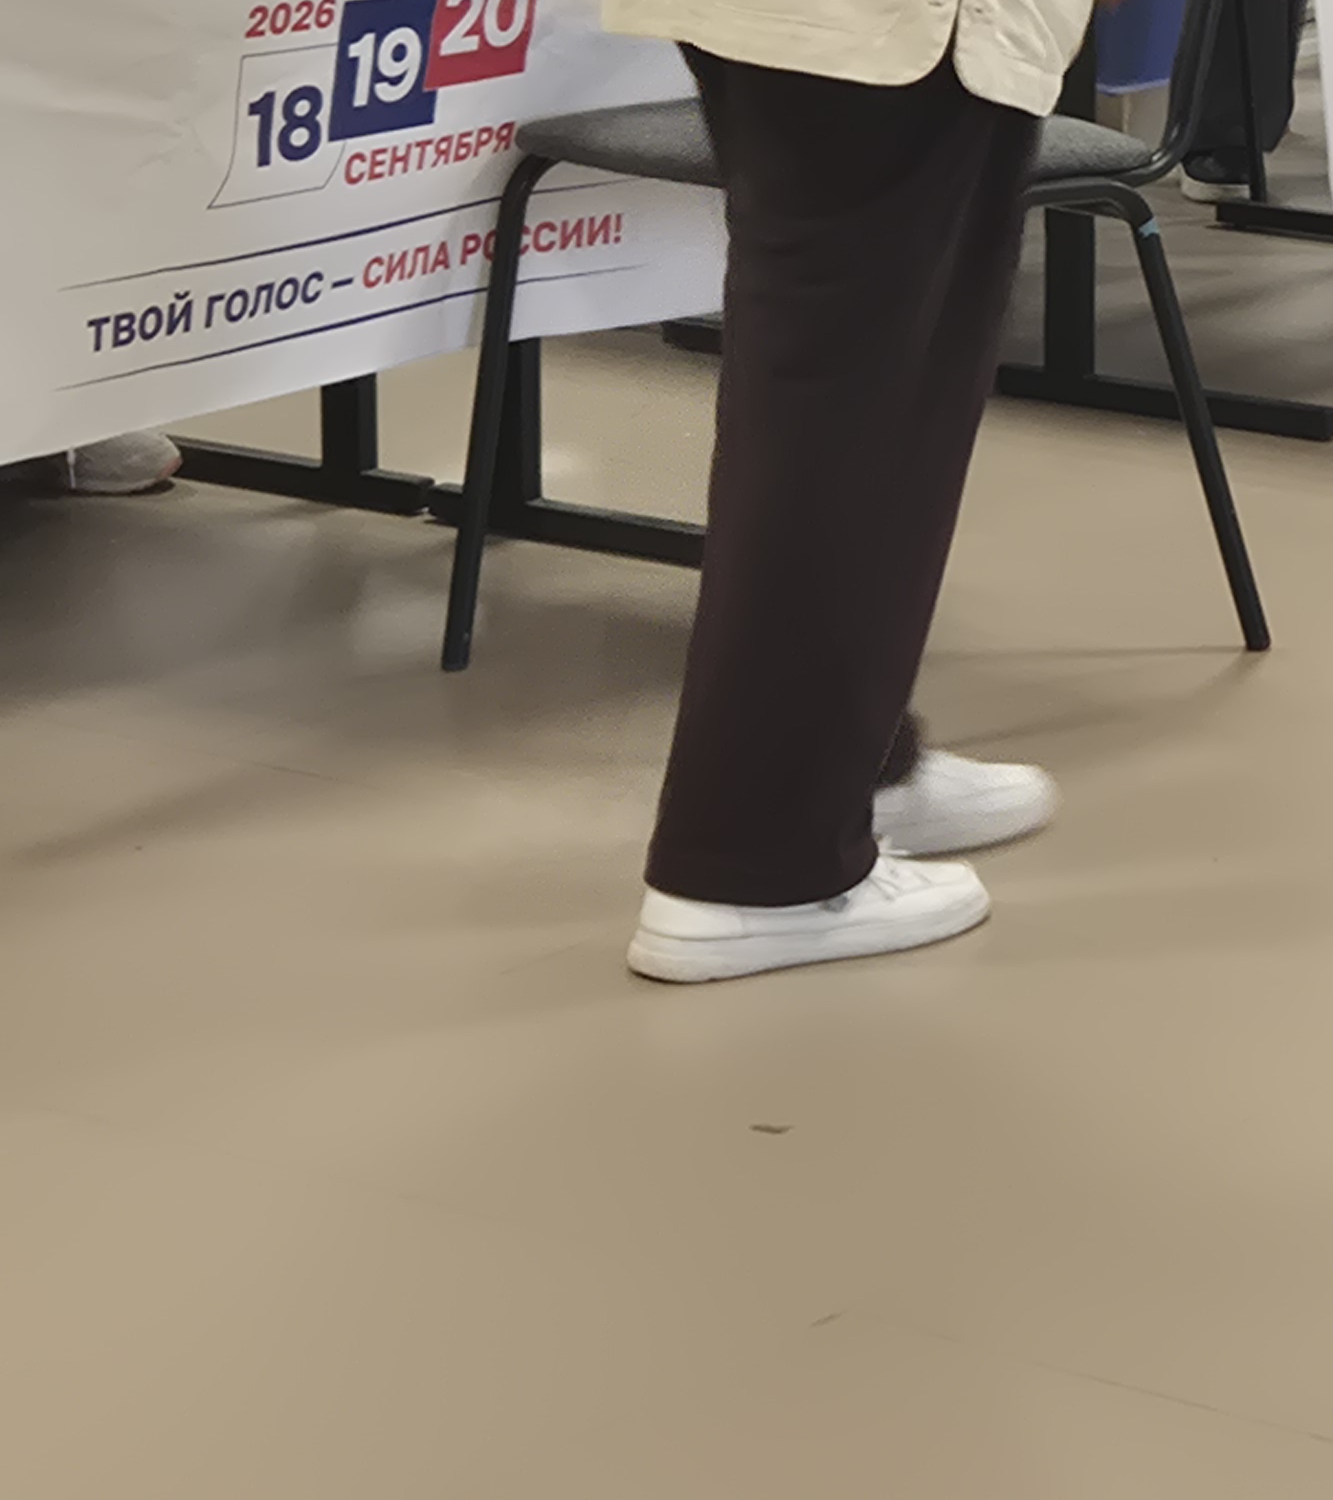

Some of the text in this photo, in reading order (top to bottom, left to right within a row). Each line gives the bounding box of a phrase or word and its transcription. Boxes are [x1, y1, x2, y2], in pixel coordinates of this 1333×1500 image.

[248, 85, 323, 168] 18
[348, 27, 422, 108] 19
[344, 121, 516, 186] СЕНТЯБРЯ
[87, 290, 194, 352] ТВОЙ
[204, 271, 324, 329] ГОЛОС
[362, 241, 450, 289] СИЛА
